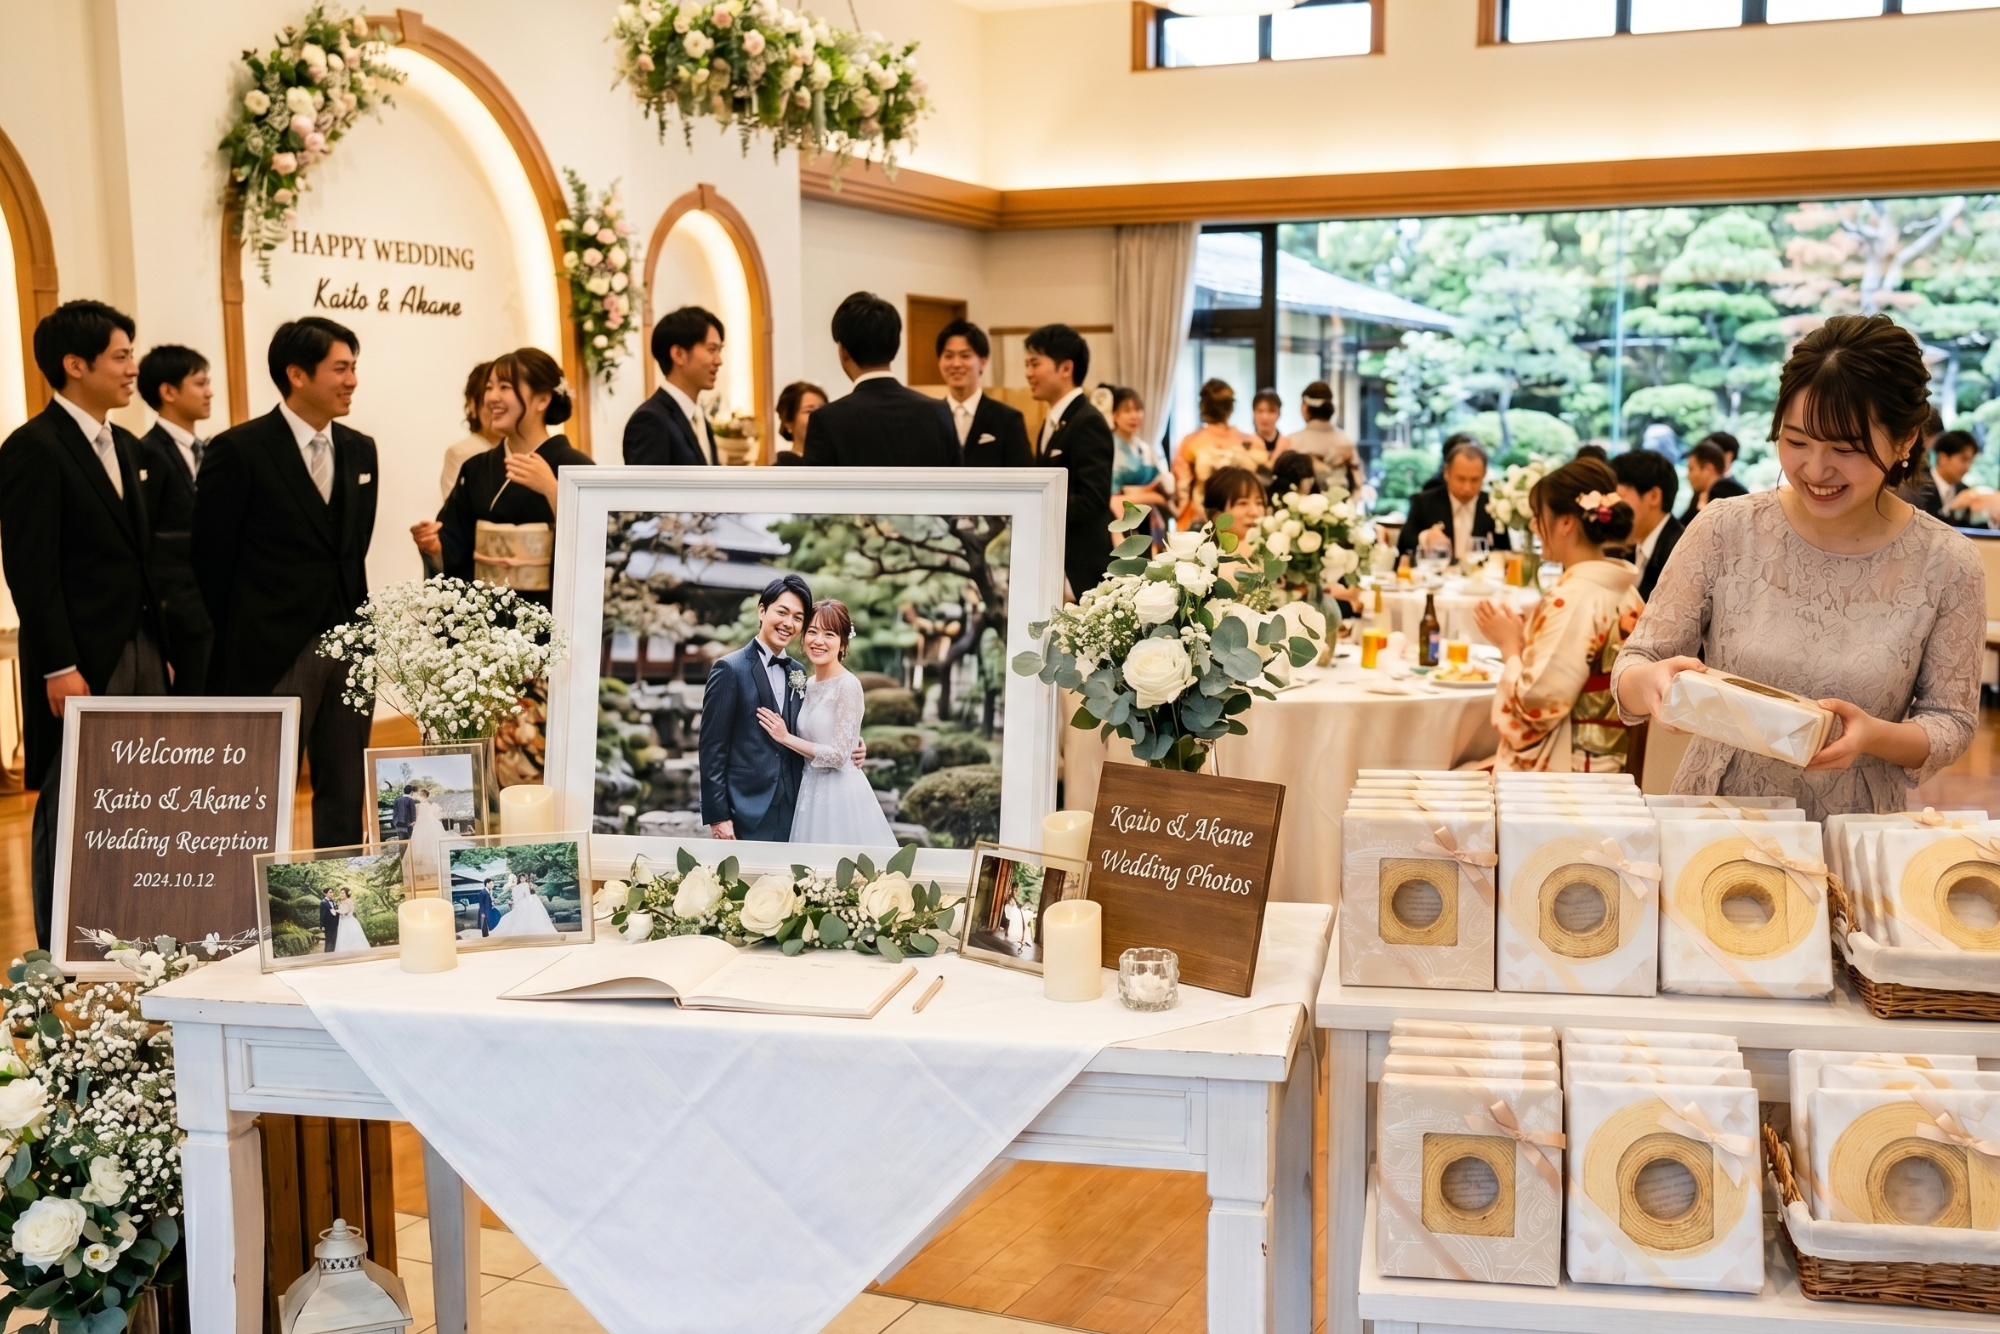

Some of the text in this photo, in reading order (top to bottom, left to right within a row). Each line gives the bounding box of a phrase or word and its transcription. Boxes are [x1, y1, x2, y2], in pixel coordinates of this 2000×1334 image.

[292, 230, 475, 271] HAPPY WEDDING
[314, 277, 462, 317] Kaito & Akane
[111, 737, 246, 765] Welcome to
[93, 786, 267, 815] Kaito & Akane's
[85, 828, 269, 857] Wedding Reception
[1166, 812, 1189, 839] &
[1185, 817, 1254, 848] Akane
[133, 872, 215, 887] 2024.10.12
[1101, 849, 1253, 896] Wedding Photos
